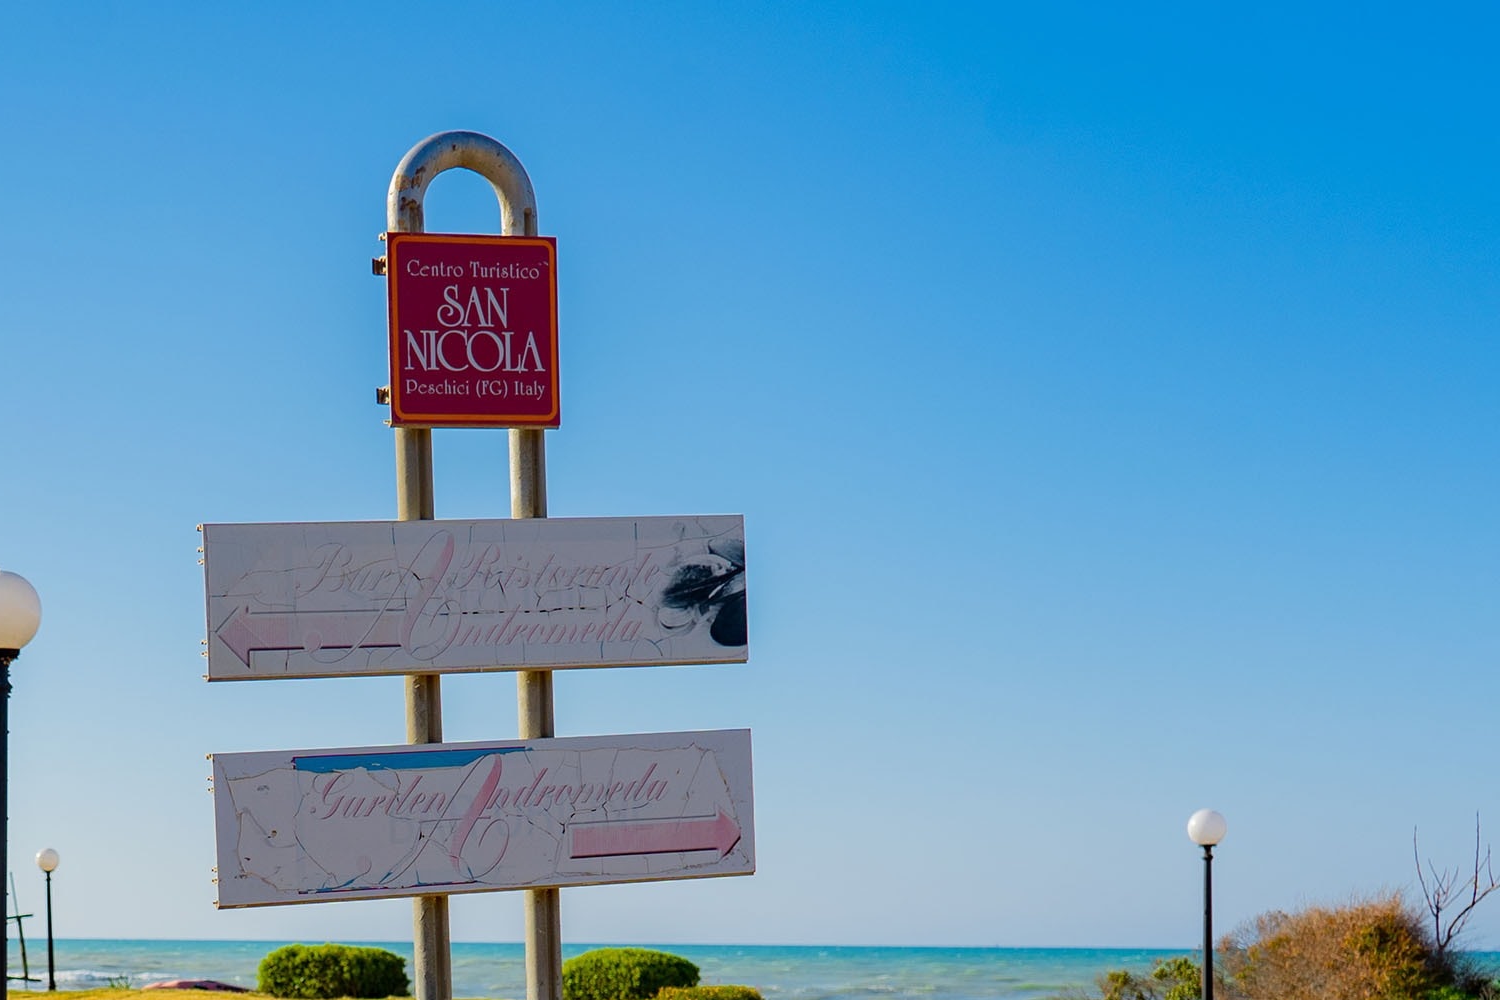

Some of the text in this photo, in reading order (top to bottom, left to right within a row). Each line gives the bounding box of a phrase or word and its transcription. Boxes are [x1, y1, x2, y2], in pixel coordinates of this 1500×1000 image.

[406, 259, 540, 279] Centro Turistico
[437, 284, 510, 328] SAN
[404, 329, 546, 373] NICOLA
[406, 379, 546, 400] Peschici (FG) Italy
[296, 543, 394, 597] Bar
[310, 772, 448, 819] Garden
